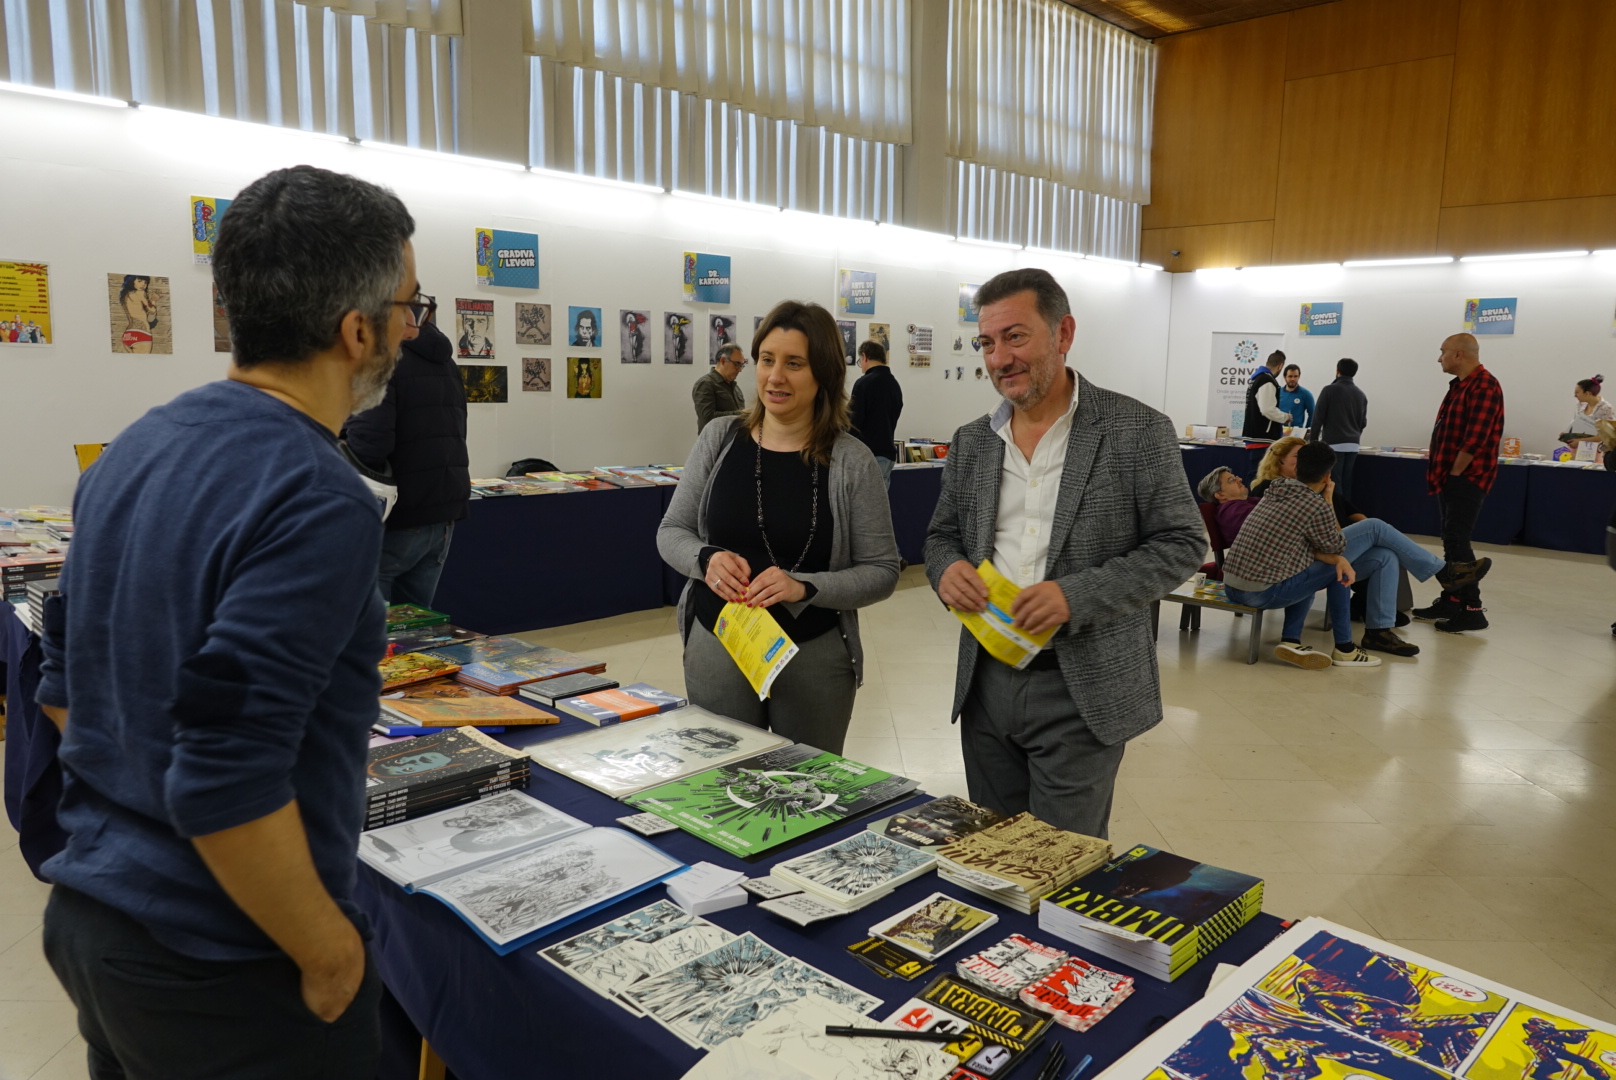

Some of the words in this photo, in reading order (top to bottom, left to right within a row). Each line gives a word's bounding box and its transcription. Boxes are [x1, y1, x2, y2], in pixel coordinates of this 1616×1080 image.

[497, 249, 535, 259] GRADIVA
[498, 258, 504, 268] /
[505, 258, 536, 268] LEVOIR
[707, 269, 720, 278] DR.
[698, 277, 730, 286] KARTOON
[851, 281, 865, 290] ARTE
[865, 281, 874, 289] DE
[851, 289, 870, 297] AUTOR
[854, 296, 871, 305] DEVIR
[1310, 312, 1341, 321] CONVER-
[1482, 307, 1510, 317] BRUAÁ
[1313, 318, 1338, 326] GÊNCIA
[1478, 314, 1513, 323] EDITORA
[1041, 885, 1186, 942] UMBRA
[965, 956, 1016, 988] UMBRA
[1033, 985, 1096, 1018] UMBRA
[939, 984, 1022, 1032] UMBRA
[971, 1060, 993, 1074] UMBRA
